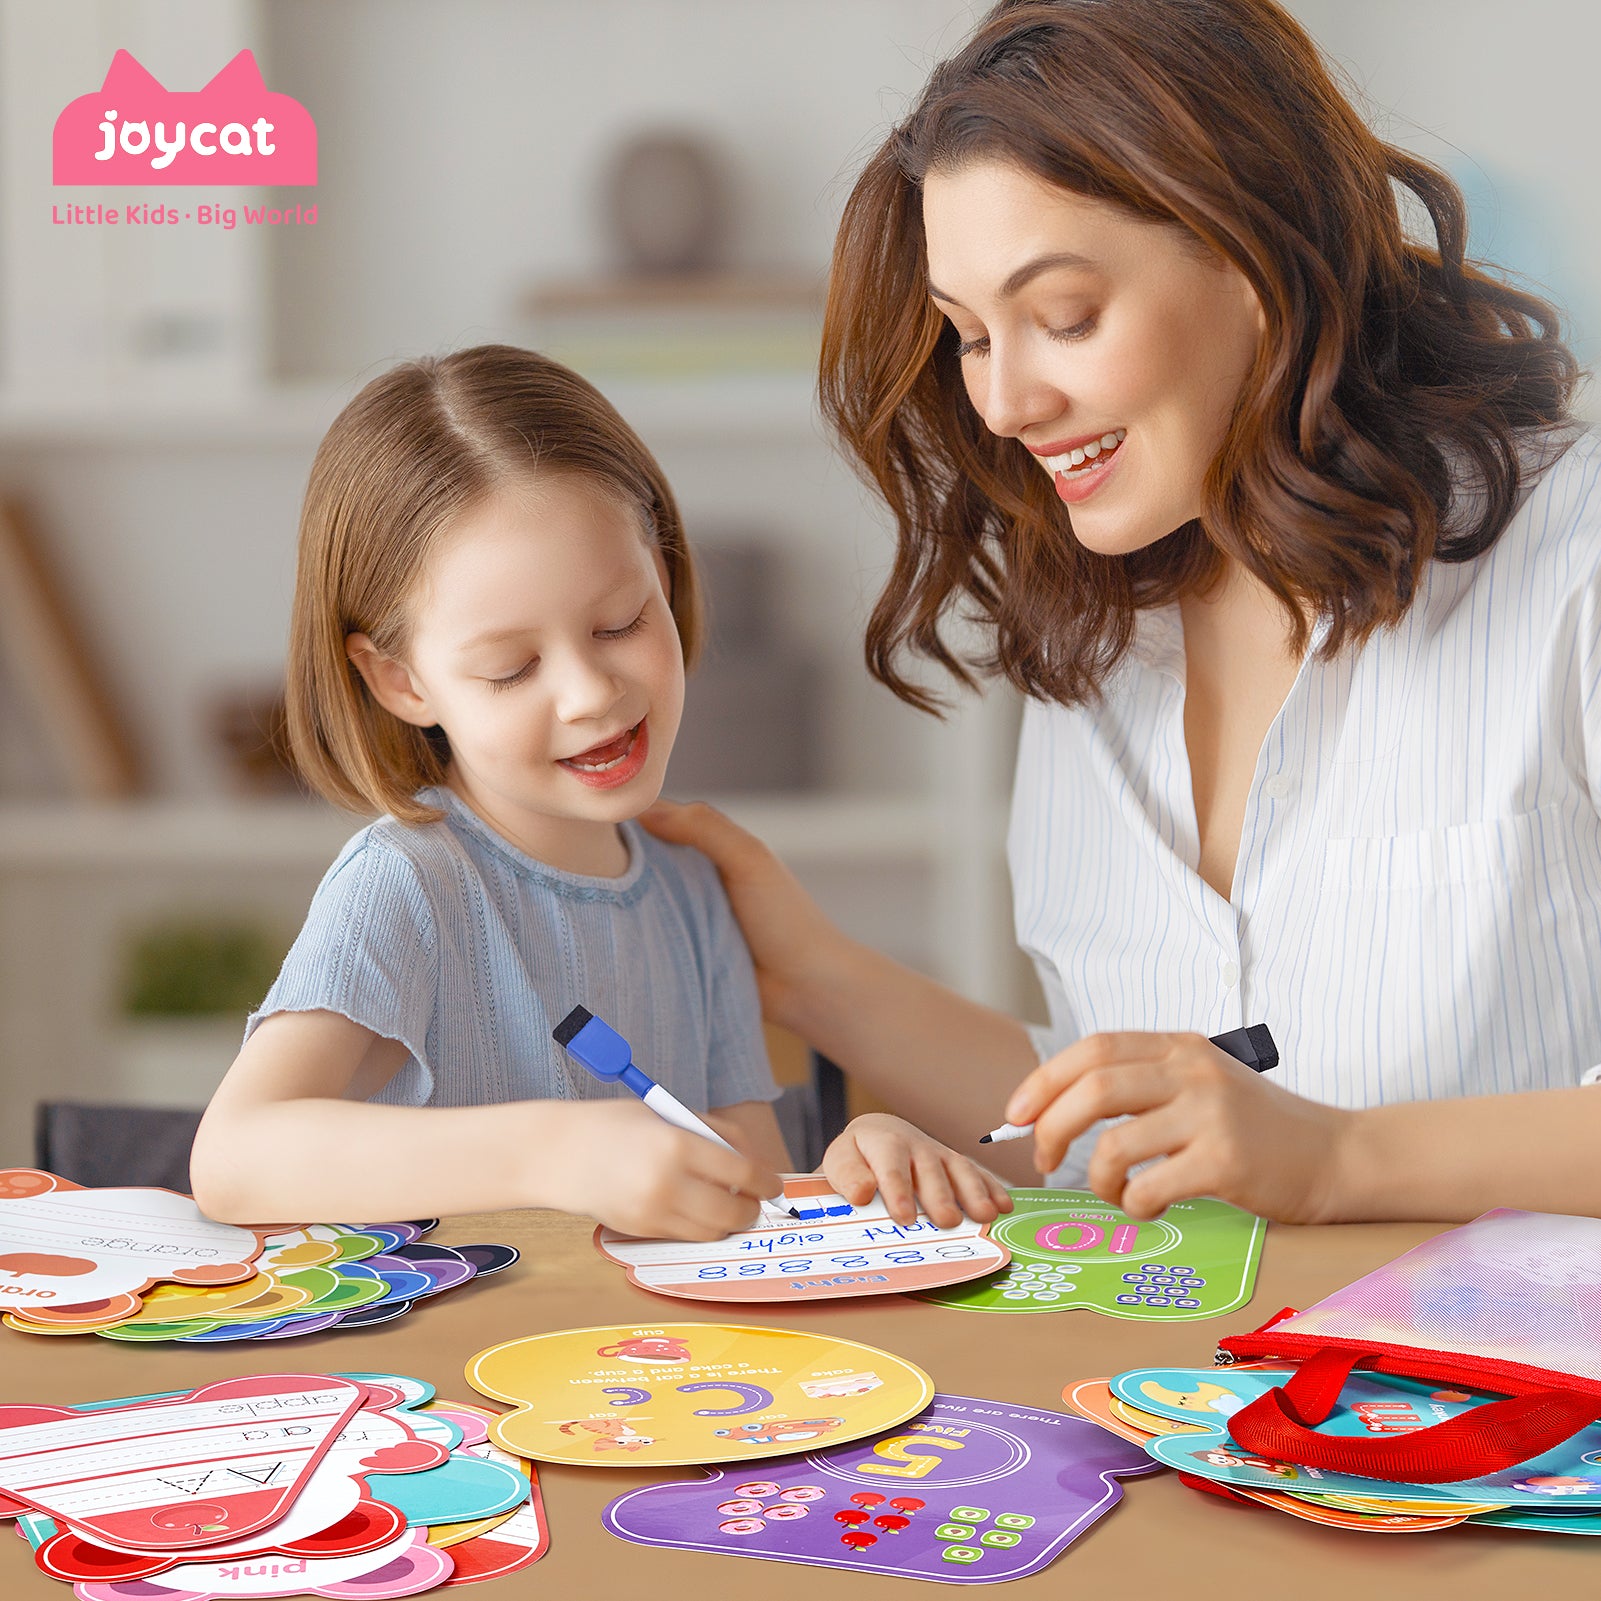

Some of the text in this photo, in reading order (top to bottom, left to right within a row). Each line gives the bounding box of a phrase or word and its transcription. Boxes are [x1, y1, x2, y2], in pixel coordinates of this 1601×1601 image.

[1069, 1212, 1117, 1222] Ten
[739, 1220, 940, 1253] ight eight
[1034, 1221, 1140, 1254] 10
[81, 1237, 220, 1257] orange
[884, 1250, 925, 1264] 8
[697, 1266, 728, 1279] 8
[738, 1263, 767, 1276] 8
[778, 1259, 813, 1273] 8
[789, 1274, 890, 1290] Eight
[632, 1328, 665, 1337] cup
[587, 1368, 628, 1376] cup.
[650, 1366, 682, 1375] and
[690, 1363, 727, 1372] cake
[728, 1366, 783, 1377] There
[810, 1368, 855, 1377] cake
[569, 1376, 650, 1385] between
[656, 1373, 685, 1382] cat
[708, 1371, 723, 1379] is
[217, 1394, 339, 1417] apple
[757, 1413, 788, 1421] car
[933, 1402, 1062, 1426] There are five
[907, 1422, 972, 1438] Five
[855, 1435, 966, 1479] 5
[218, 1559, 307, 1580] pink
